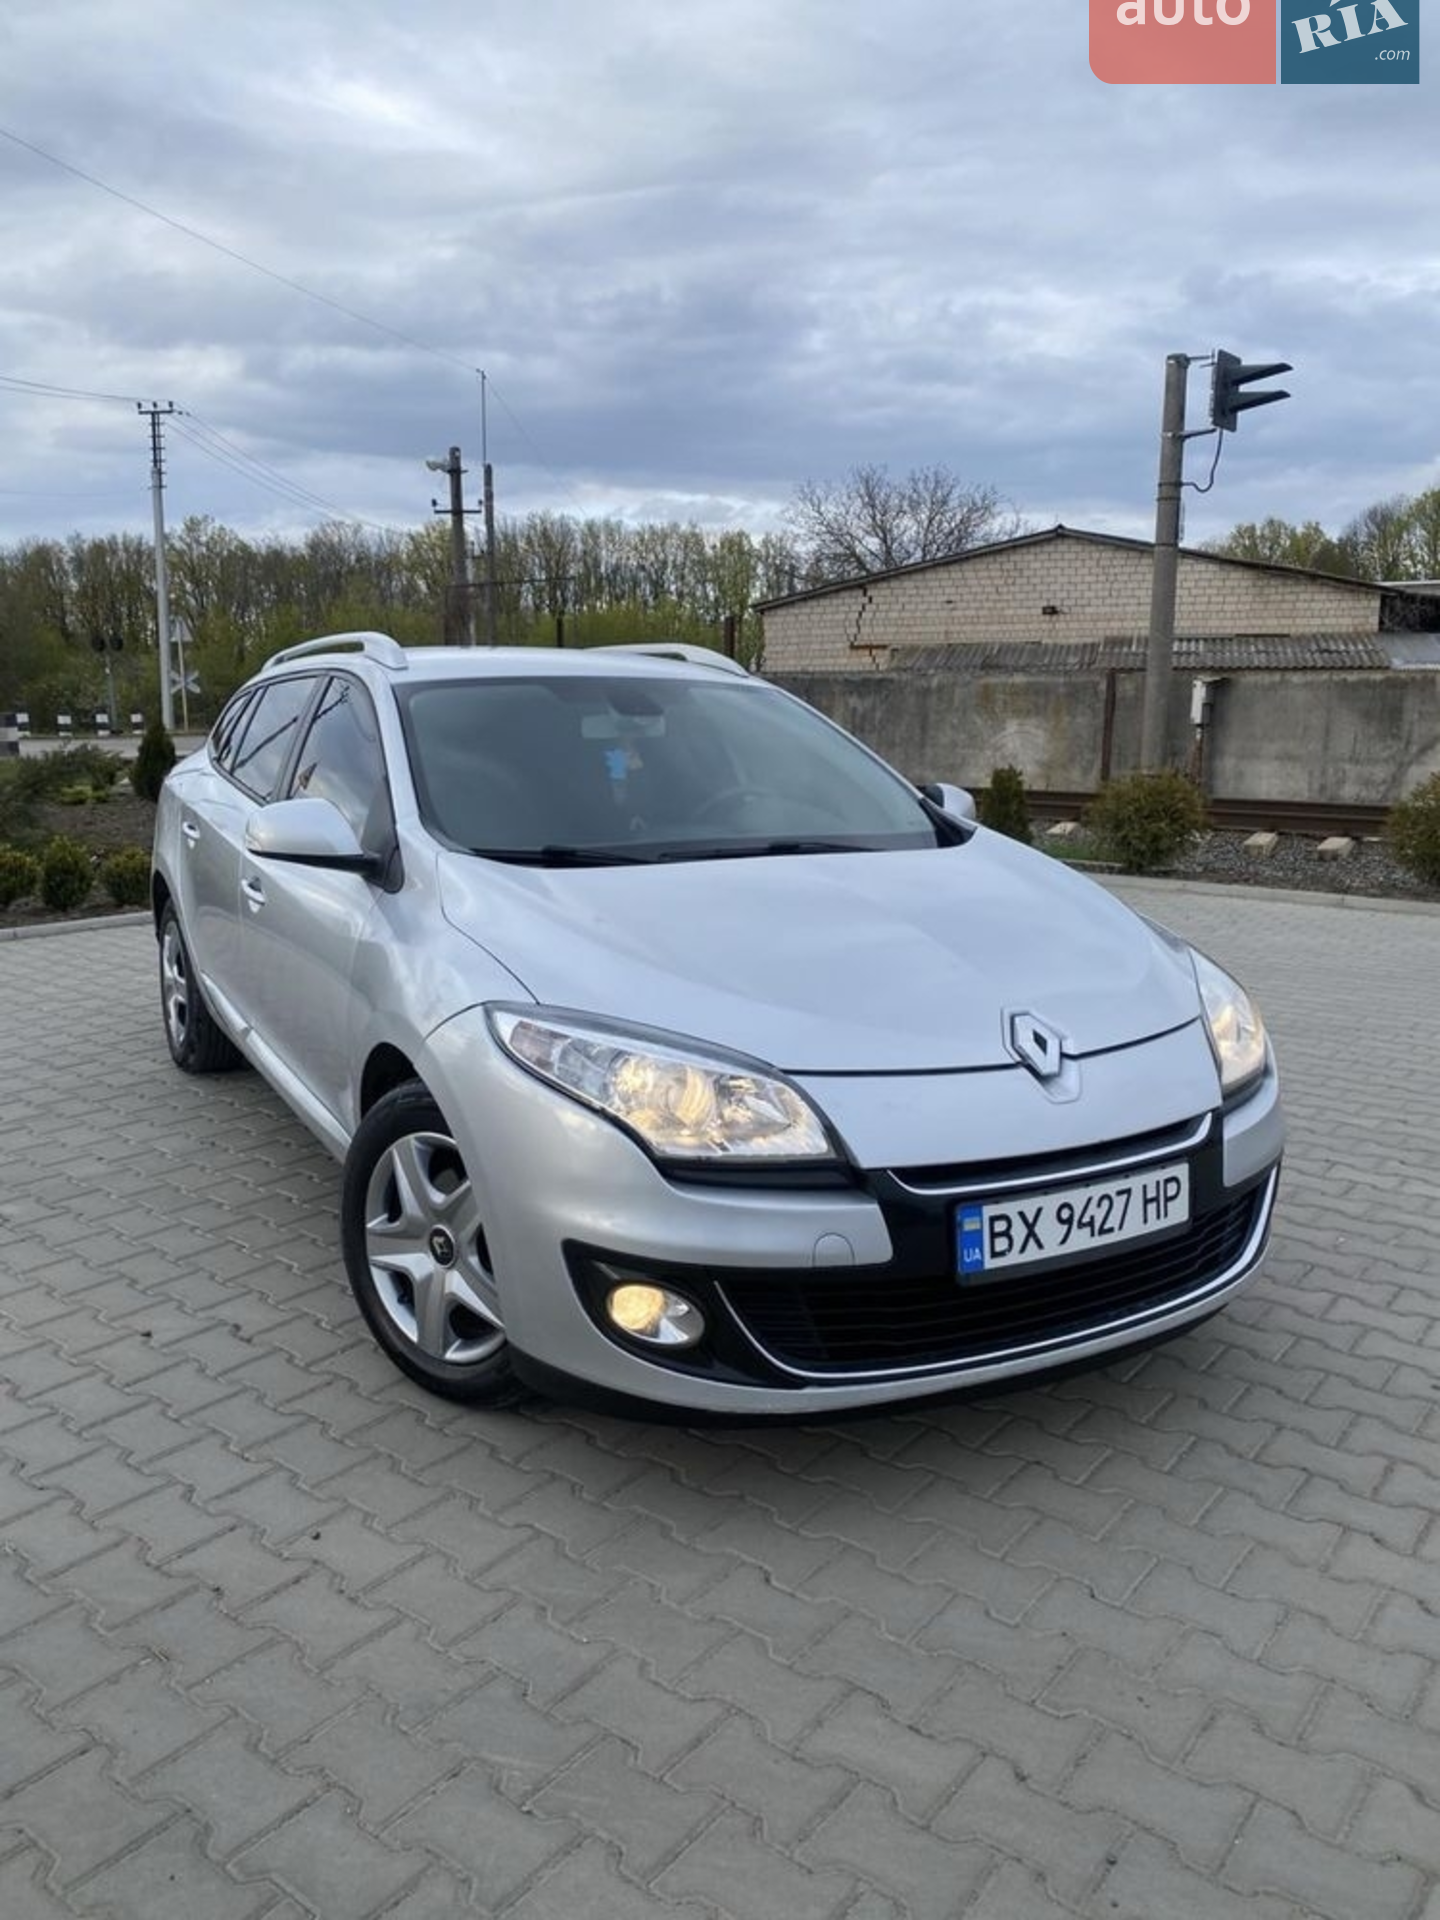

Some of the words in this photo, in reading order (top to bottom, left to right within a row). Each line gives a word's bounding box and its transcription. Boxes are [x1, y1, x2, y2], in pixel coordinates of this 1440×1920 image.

[988, 1207, 1045, 1259] BX
[1056, 1187, 1132, 1246] 9427
[1142, 1175, 1182, 1225] HP
[963, 1248, 982, 1263] UA
